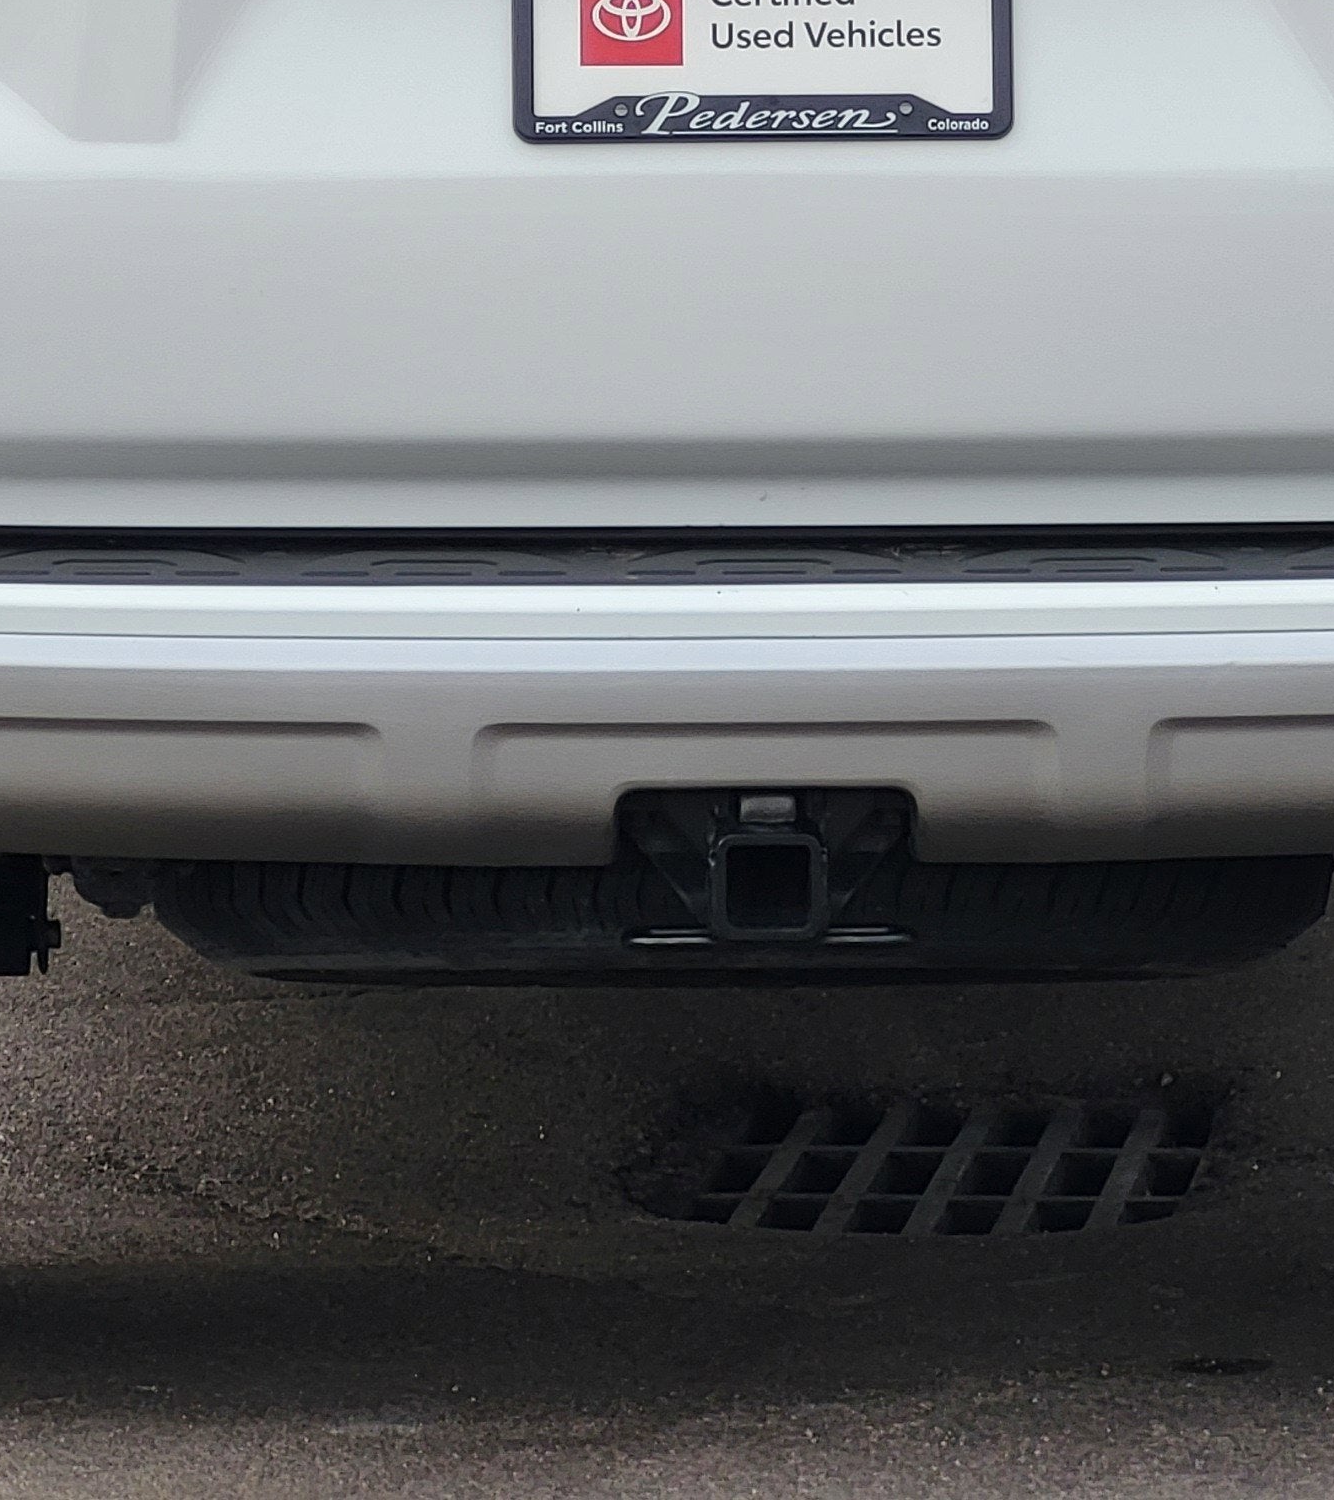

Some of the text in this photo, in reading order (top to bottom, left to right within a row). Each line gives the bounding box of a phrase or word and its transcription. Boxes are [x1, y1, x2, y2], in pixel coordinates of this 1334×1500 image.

[710, 19, 942, 50] Used Vehicles
[634, 91, 897, 135] Pedersen
[927, 117, 990, 132] Colorado
[535, 119, 624, 135] Fort Collins
